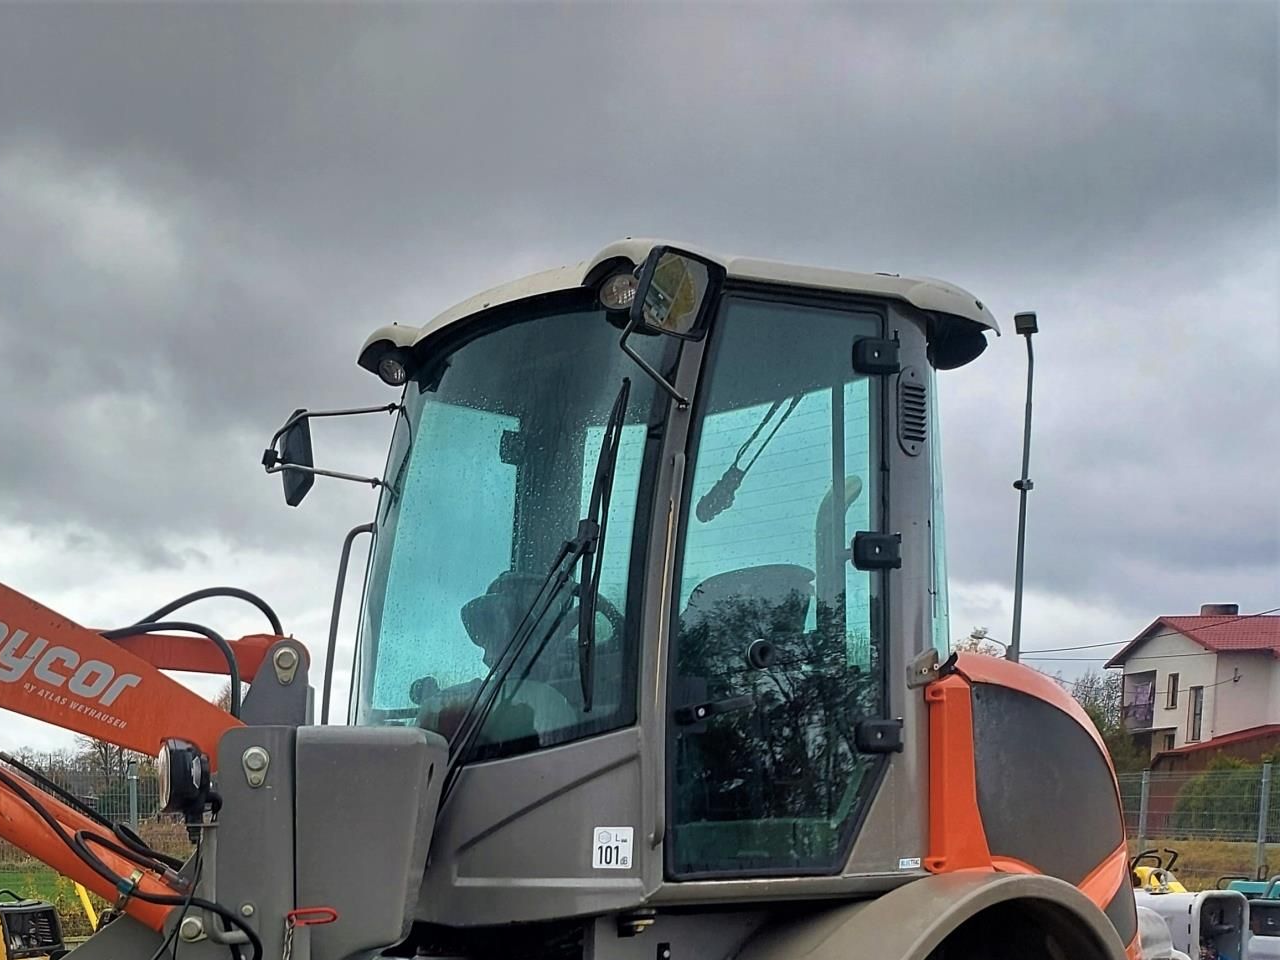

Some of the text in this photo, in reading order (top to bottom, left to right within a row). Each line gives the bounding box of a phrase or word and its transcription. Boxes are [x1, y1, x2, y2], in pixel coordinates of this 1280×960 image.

[38, 689, 68, 705] ATLAS
[69, 701, 128, 729] WEYHAUSEN
[597, 845, 620, 865] 101
